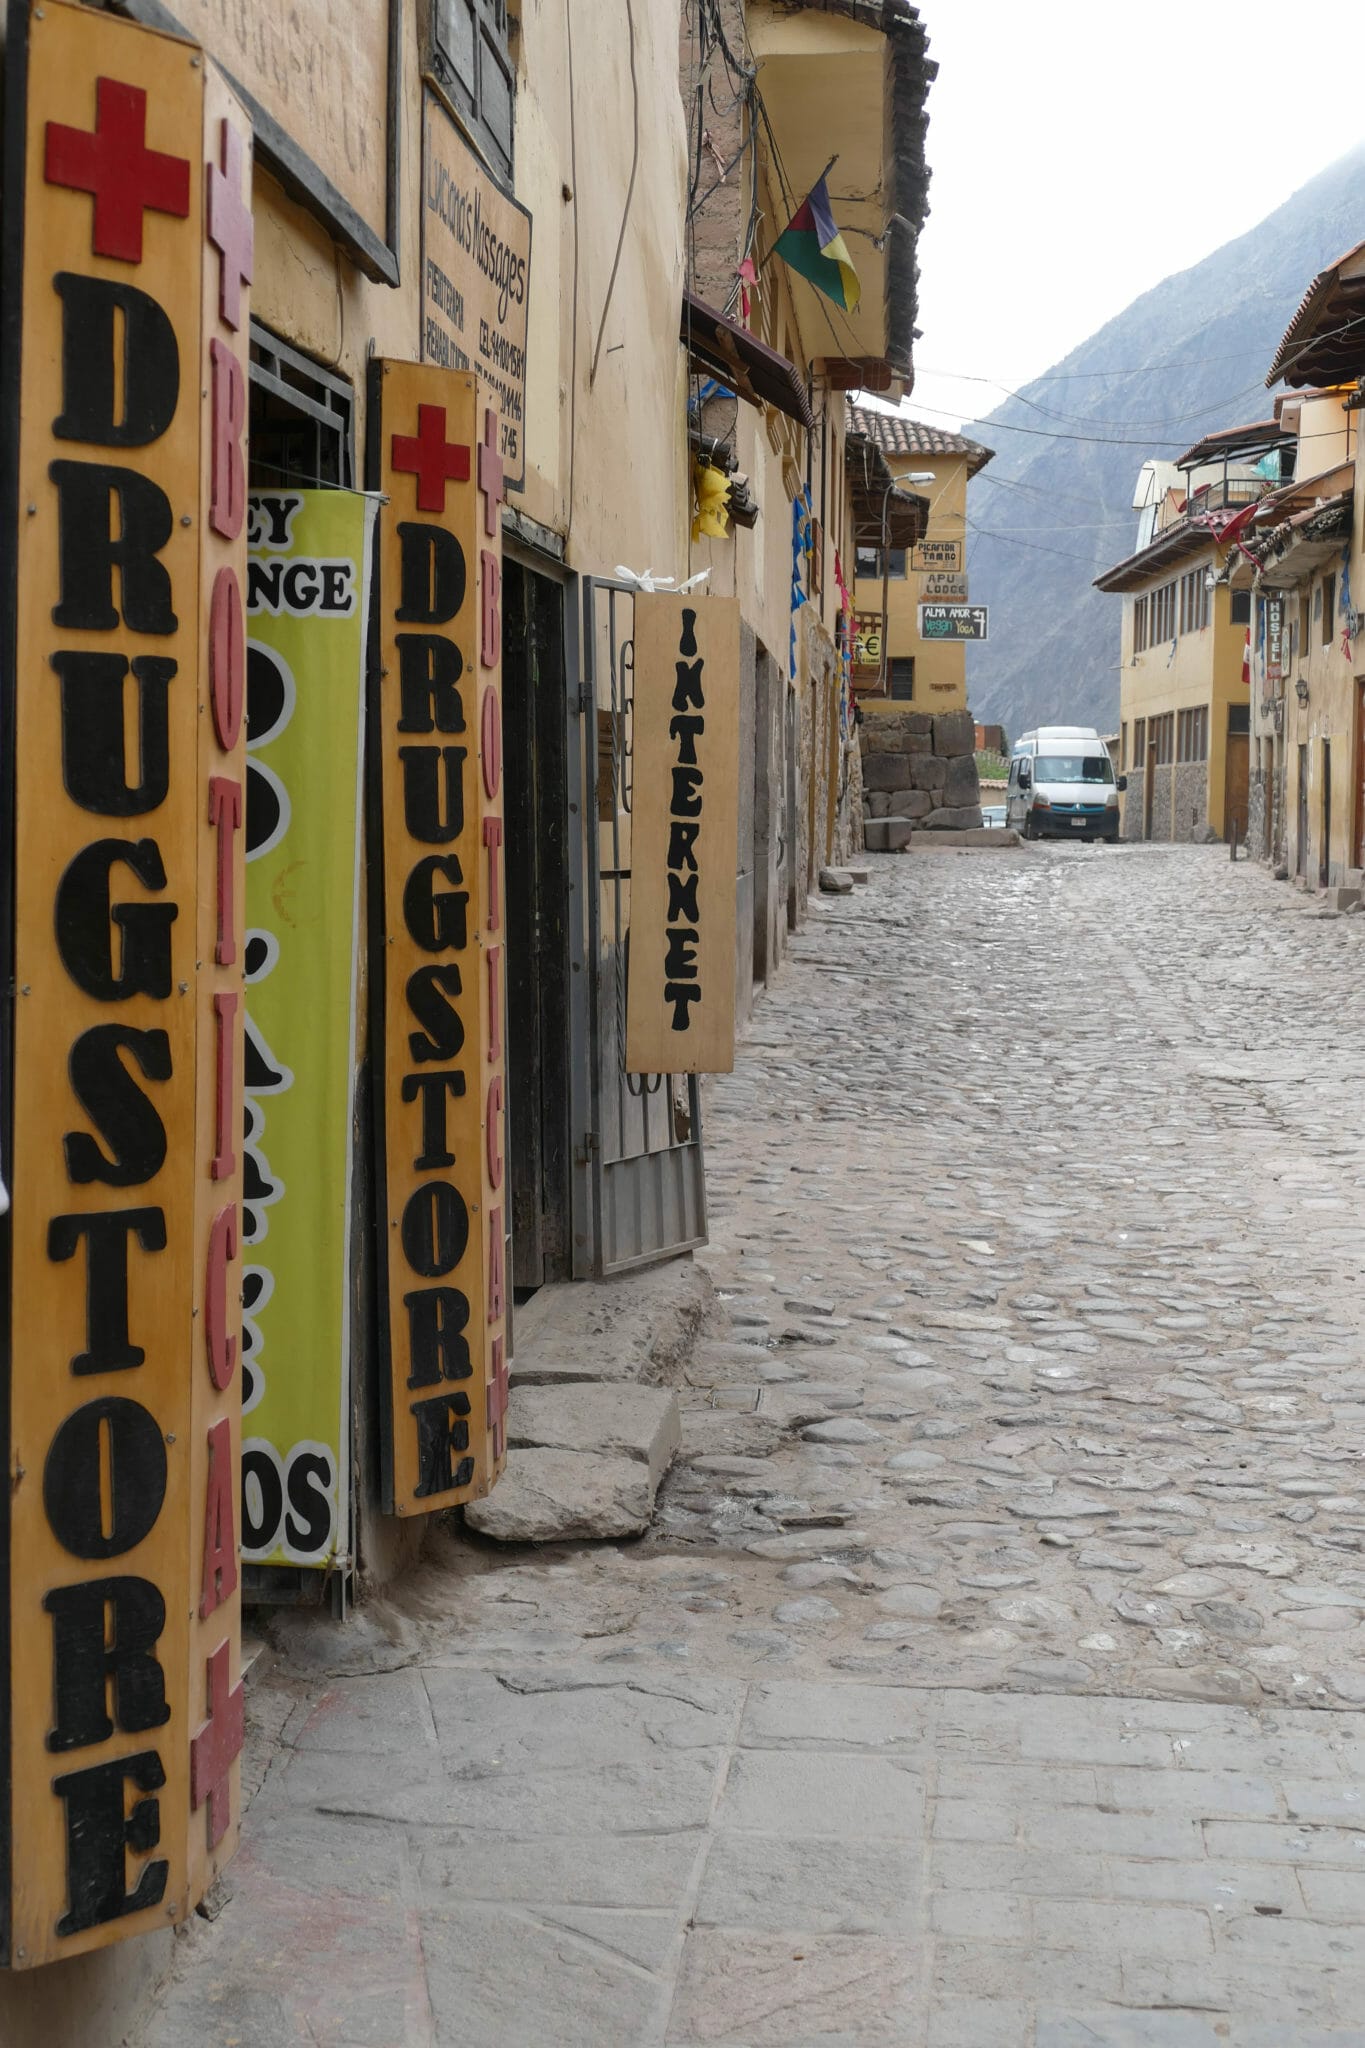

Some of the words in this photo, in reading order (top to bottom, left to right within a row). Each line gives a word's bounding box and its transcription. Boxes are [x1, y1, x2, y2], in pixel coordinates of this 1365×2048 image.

[472, 187, 526, 324] Massages
[918, 543, 955, 552] PICAFLOR
[923, 552, 956, 561] TAMBO
[928, 574, 955, 583] APU
[925, 607, 946, 618] ALMA
[949, 608, 971, 618] AMOR
[925, 619, 953, 632] Vegan
[1270, 602, 1280, 662] HOSTEL
[664, 608, 705, 1031] INTERNET
[201, 337, 245, 1620] BOTICA
[481, 549, 503, 1325] BOTICA
[394, 521, 475, 1499] DRUGSTORE
[43, 271, 180, 1938] DRUGSTORE
